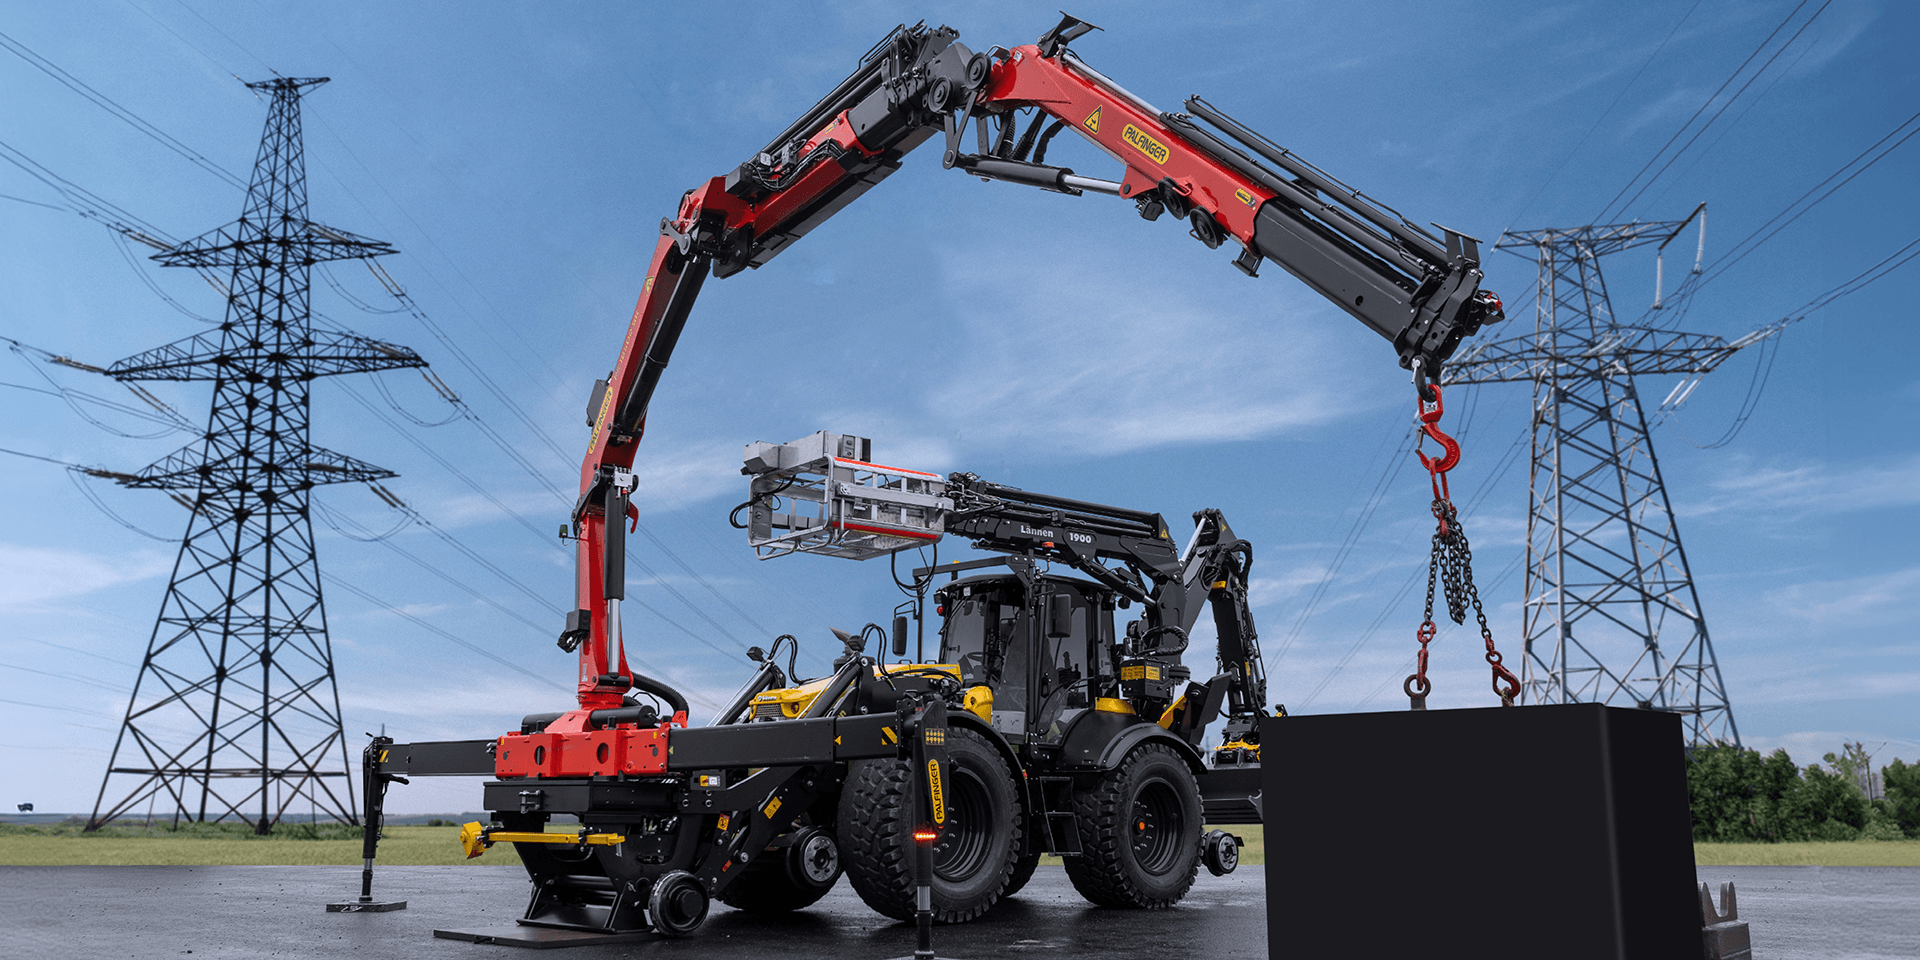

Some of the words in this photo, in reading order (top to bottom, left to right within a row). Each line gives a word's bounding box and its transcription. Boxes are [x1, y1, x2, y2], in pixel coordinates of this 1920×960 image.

[1124, 126, 1167, 162] PALFINGER
[1020, 525, 1054, 538] Lännen
[1069, 532, 1092, 544] 1900
[930, 763, 943, 820] PALFINGER
